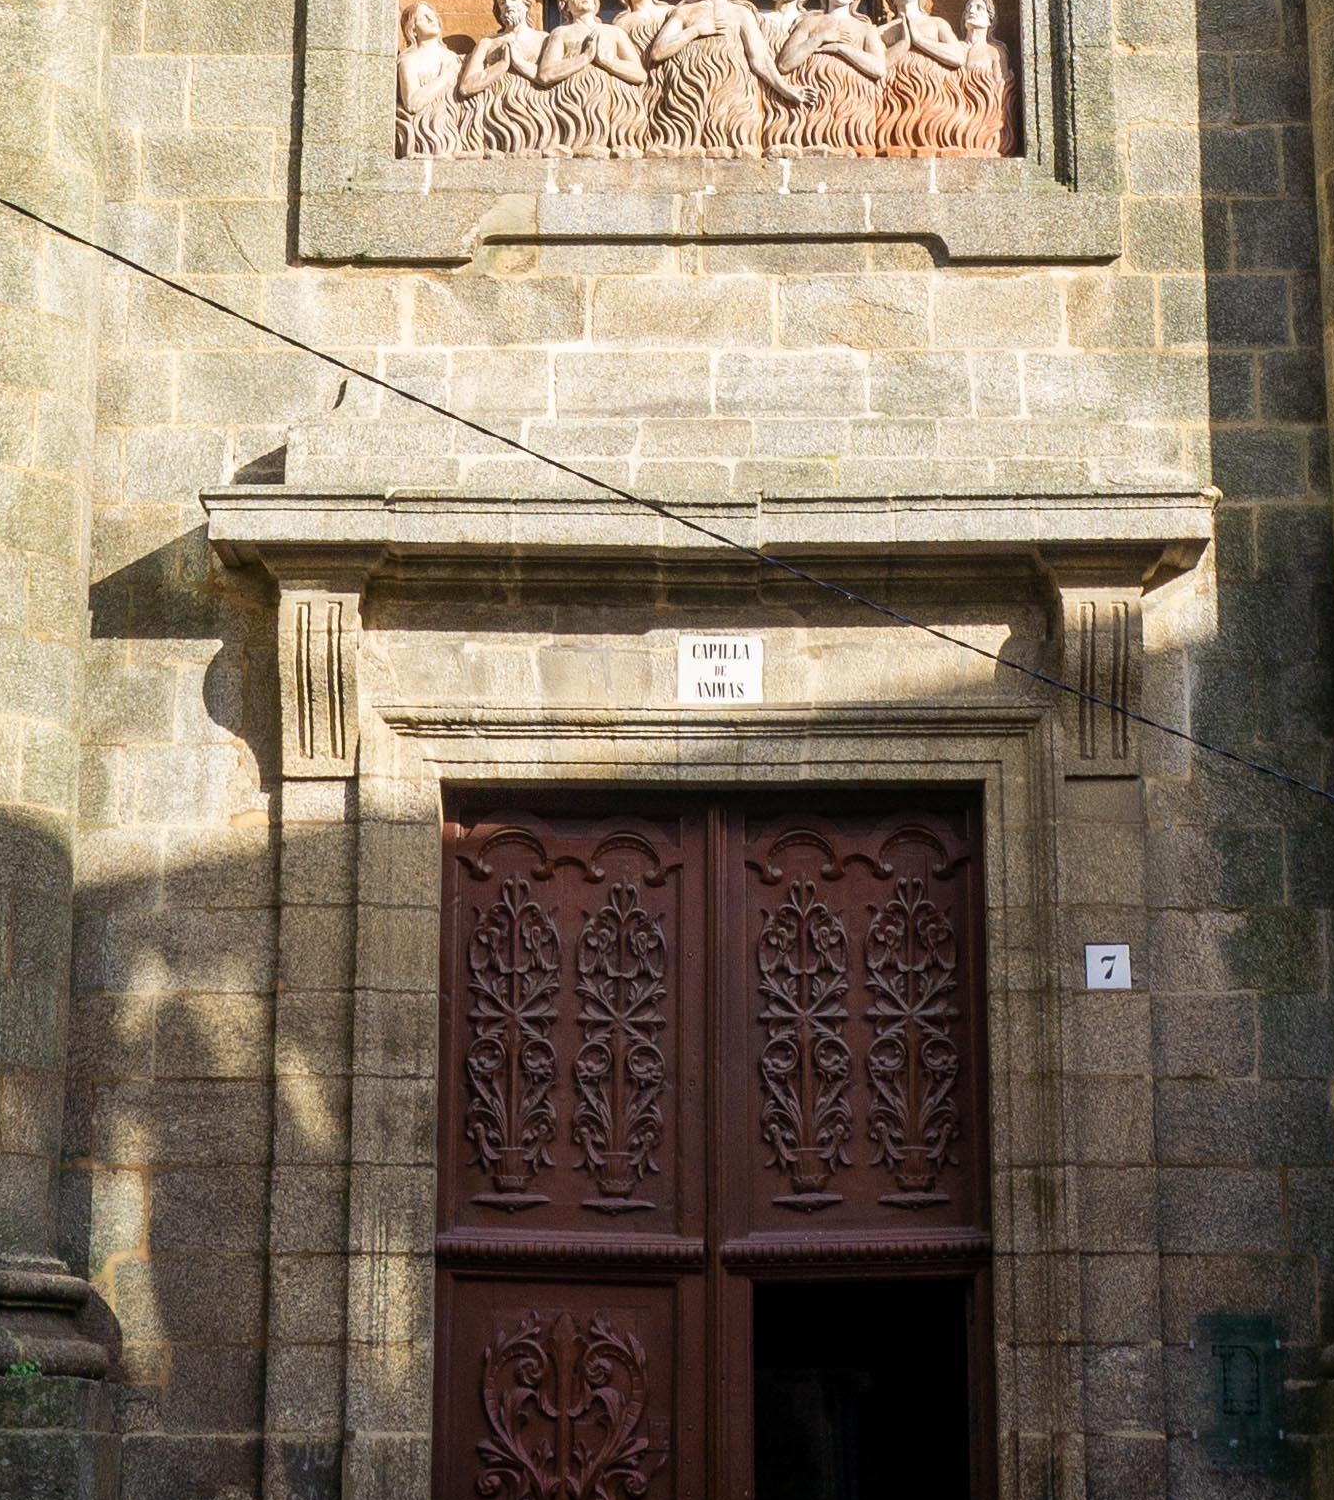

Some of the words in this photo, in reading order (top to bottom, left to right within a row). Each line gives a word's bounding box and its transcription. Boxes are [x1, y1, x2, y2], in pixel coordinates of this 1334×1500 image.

[692, 643, 750, 660] CAPILLA
[714, 665, 727, 677] DE
[1100, 954, 1117, 980] 7
